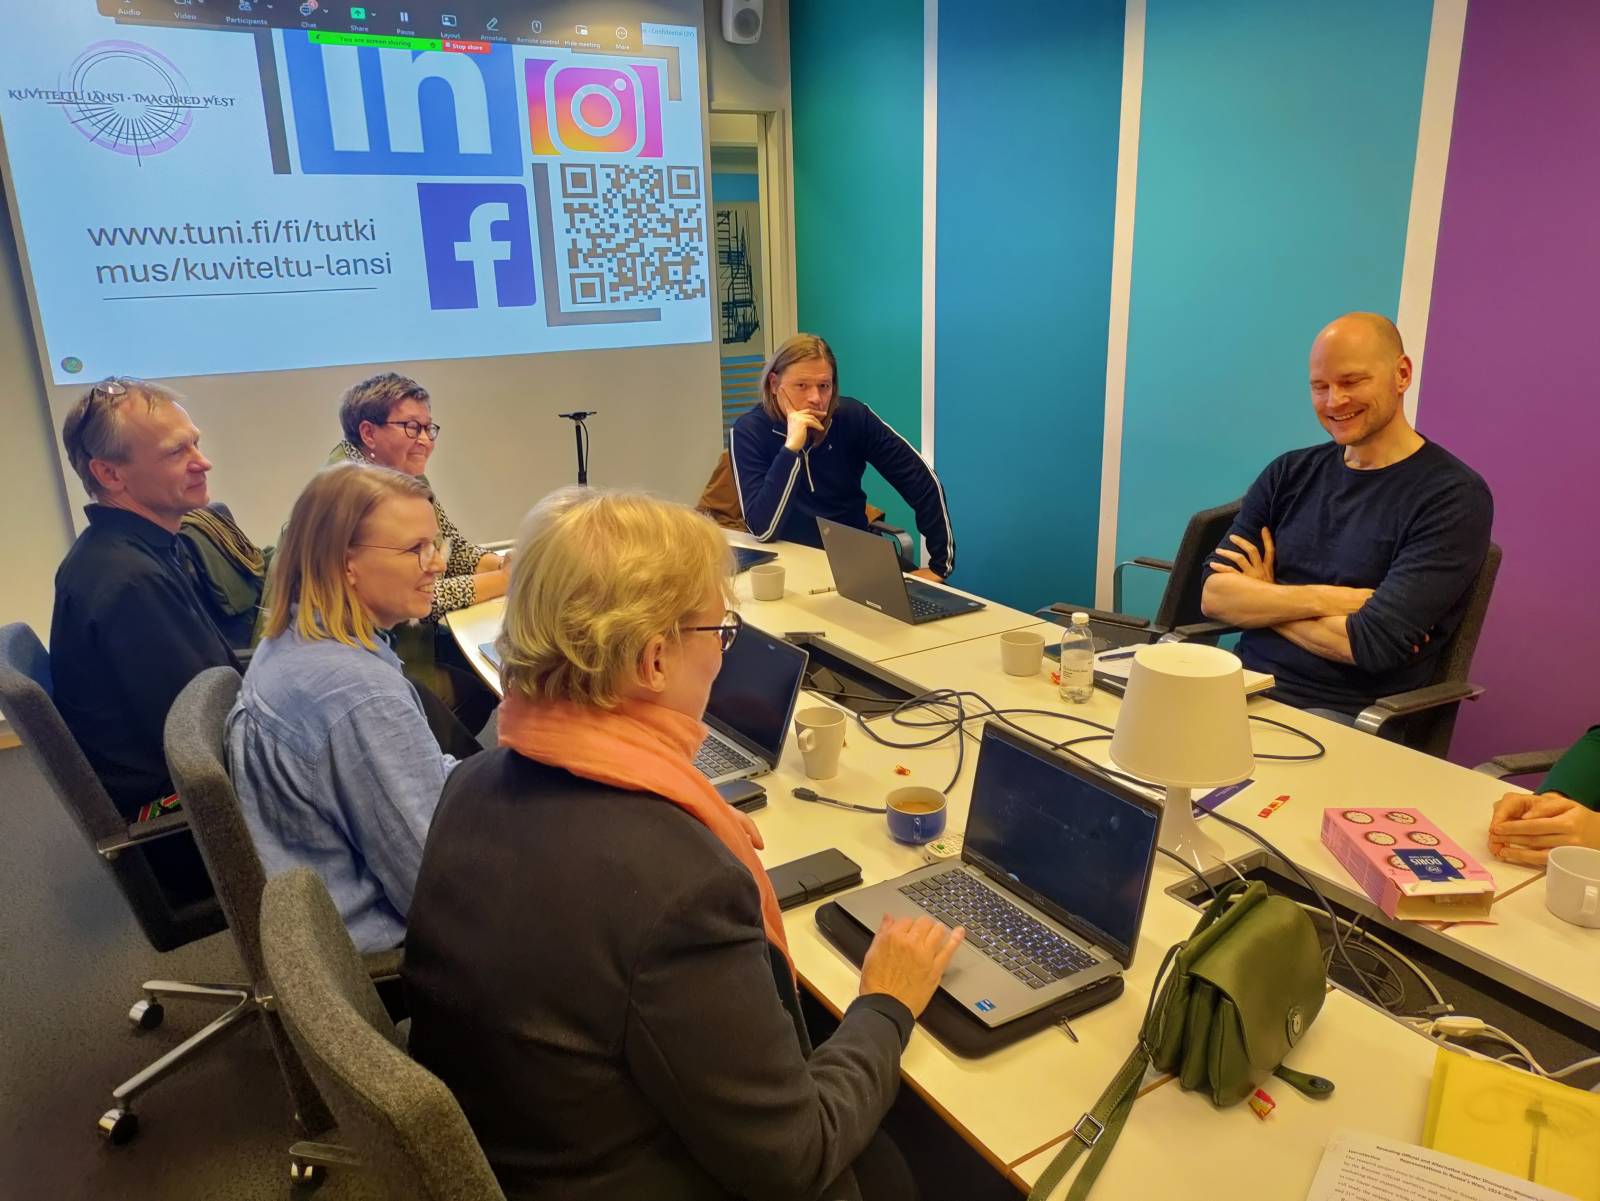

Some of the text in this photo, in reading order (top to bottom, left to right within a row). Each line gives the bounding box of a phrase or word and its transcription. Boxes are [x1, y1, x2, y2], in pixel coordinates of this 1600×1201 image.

[118, 8, 141, 16] Audio
[174, 12, 197, 20] Video
[226, 16, 268, 26] Participants
[397, 28, 415, 36] Pause
[203, 95, 235, 107] WEST
[87, 218, 376, 247] www.tuni.fi/fi/tutki
[96, 252, 392, 284] mus/kuviteltu-lansi
